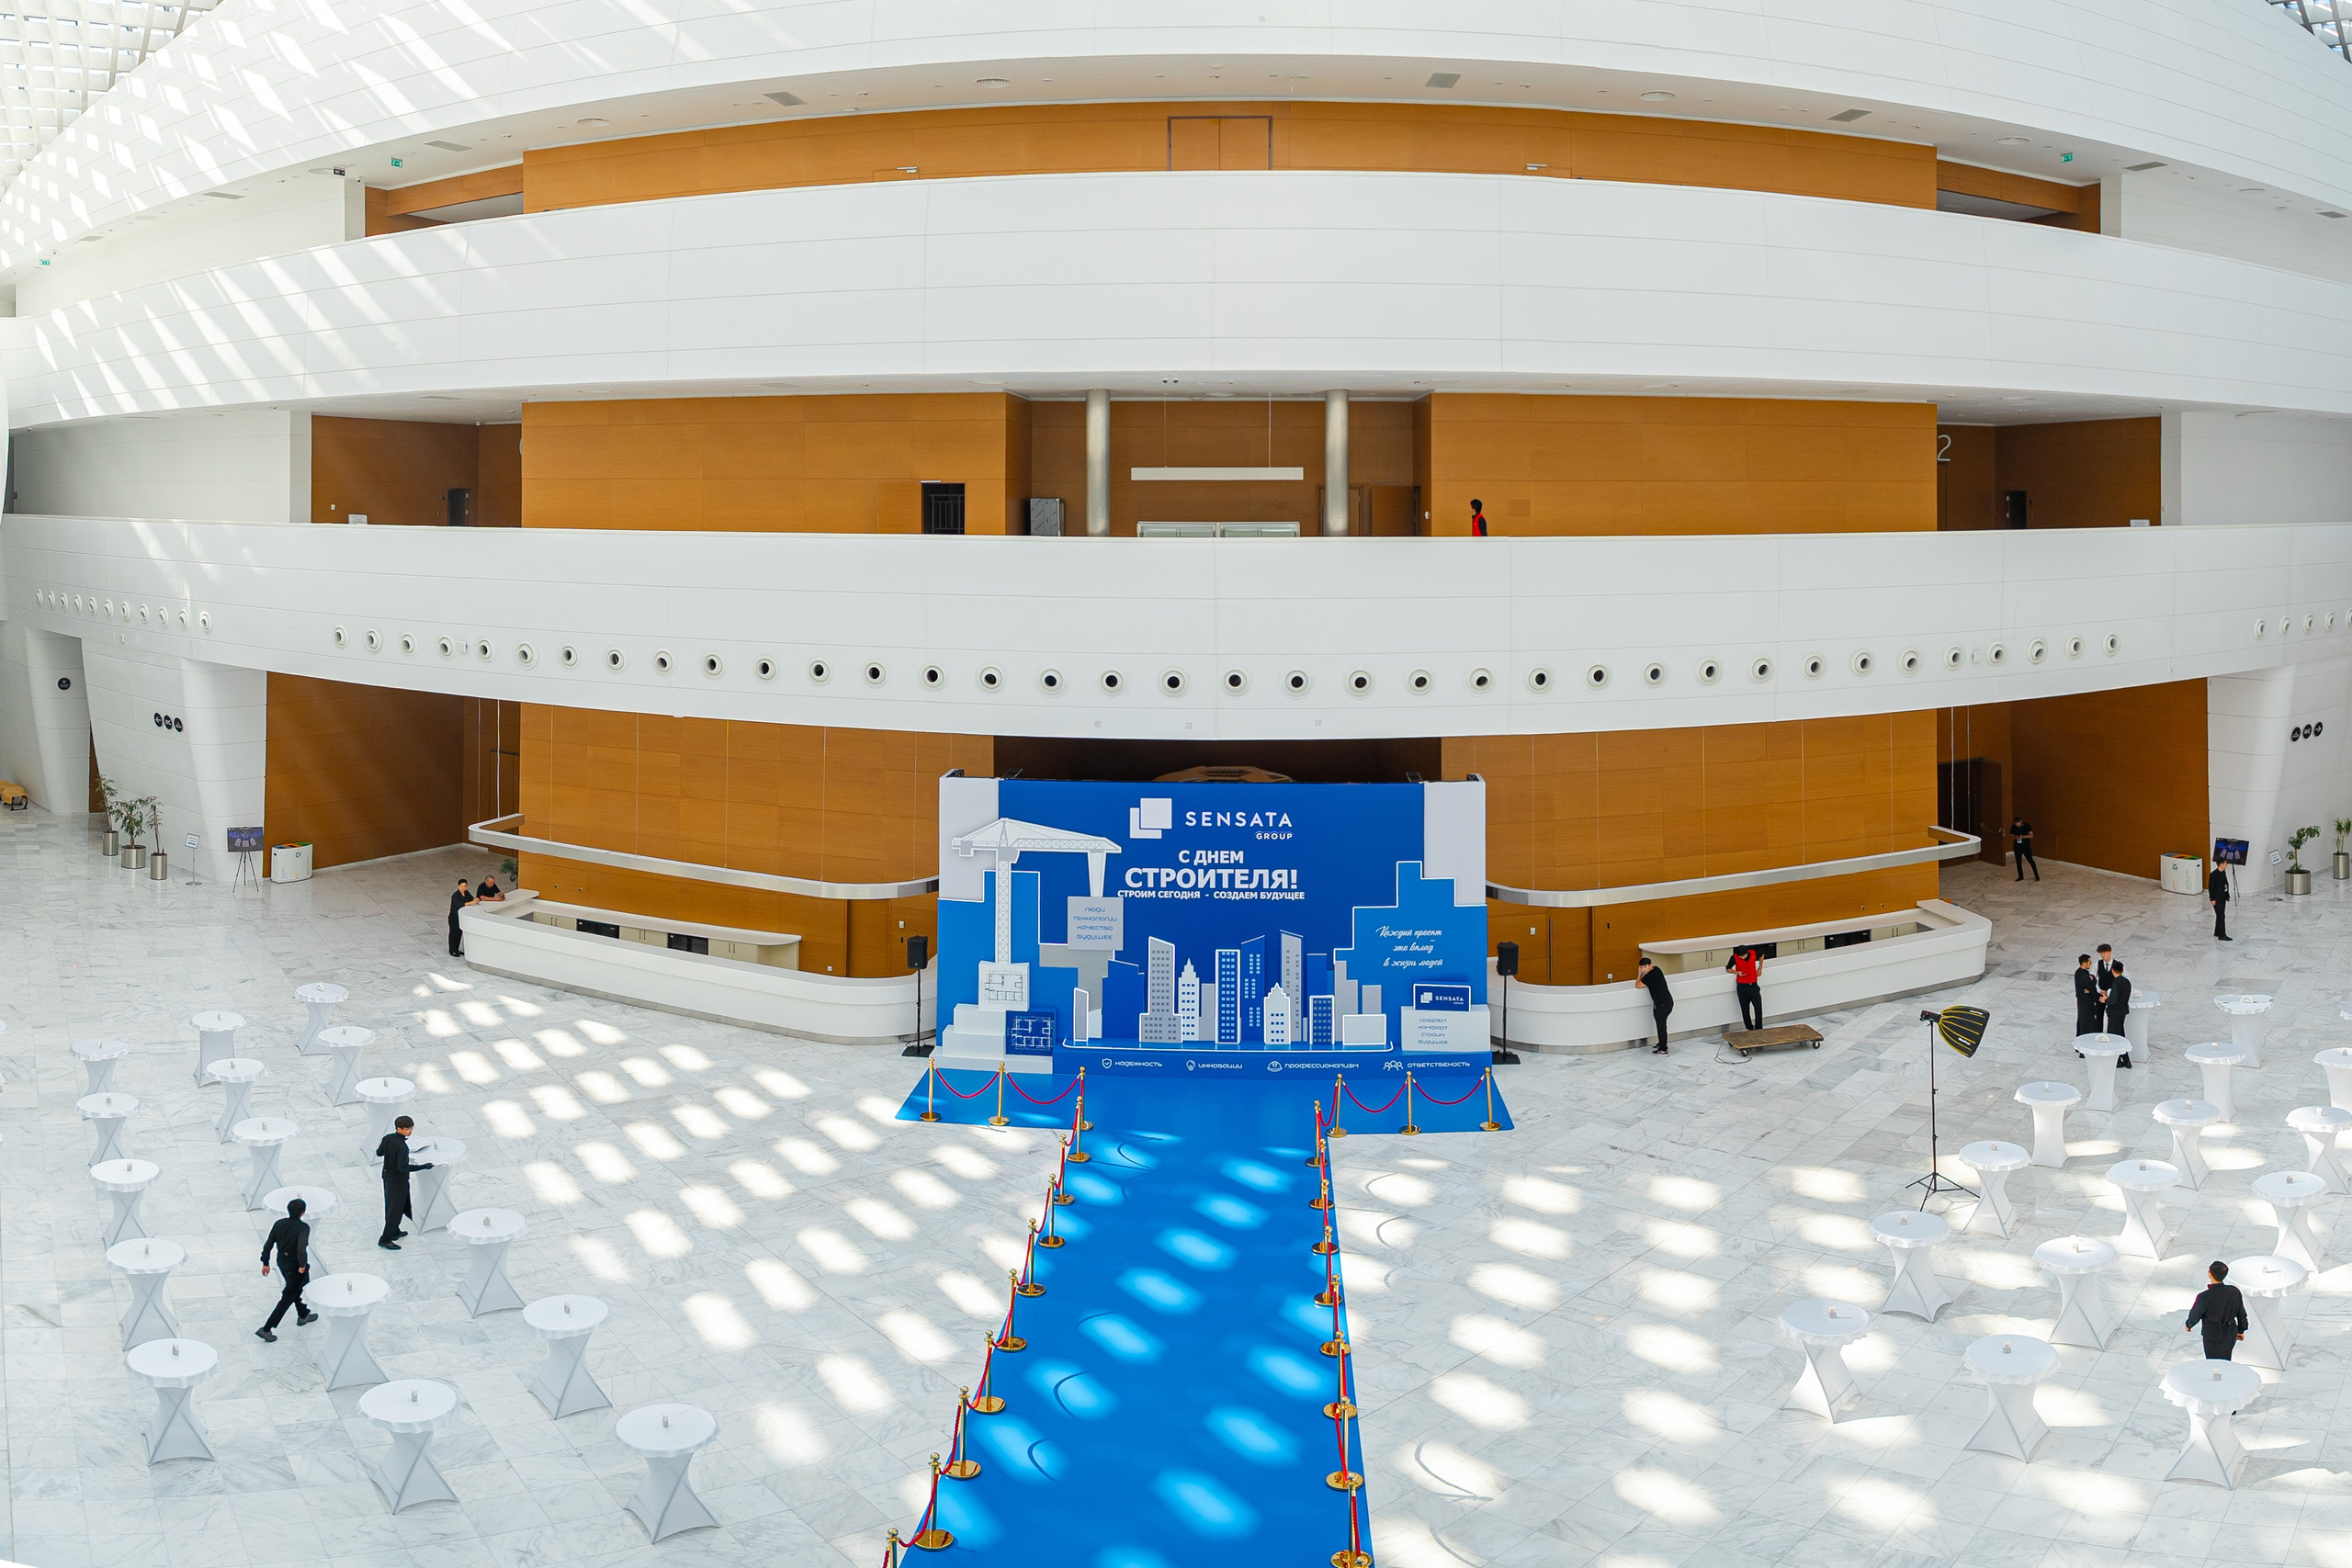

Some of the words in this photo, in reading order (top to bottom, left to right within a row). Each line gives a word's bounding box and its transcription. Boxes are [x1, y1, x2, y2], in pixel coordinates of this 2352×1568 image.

[1938, 434, 1951, 461] 2
[1185, 811, 1293, 828] SENSATA
[1178, 850, 1190, 863] С
[1193, 850, 1244, 866] ДНЕМ
[1125, 867, 1298, 889] СТРОИТЕЛЯ!
[1117, 890, 1156, 898] СТРОИМ
[1158, 890, 1201, 899] СЕГОДНЯ
[1213, 891, 1258, 900] СОЗДАЕМ
[1260, 891, 1306, 901] БУДУЩЕЕ
[1409, 942, 1434, 953] вклад
[1383, 957, 1391, 967] в
[1391, 960, 1418, 969] жизнь
[1418, 959, 1443, 968] людей
